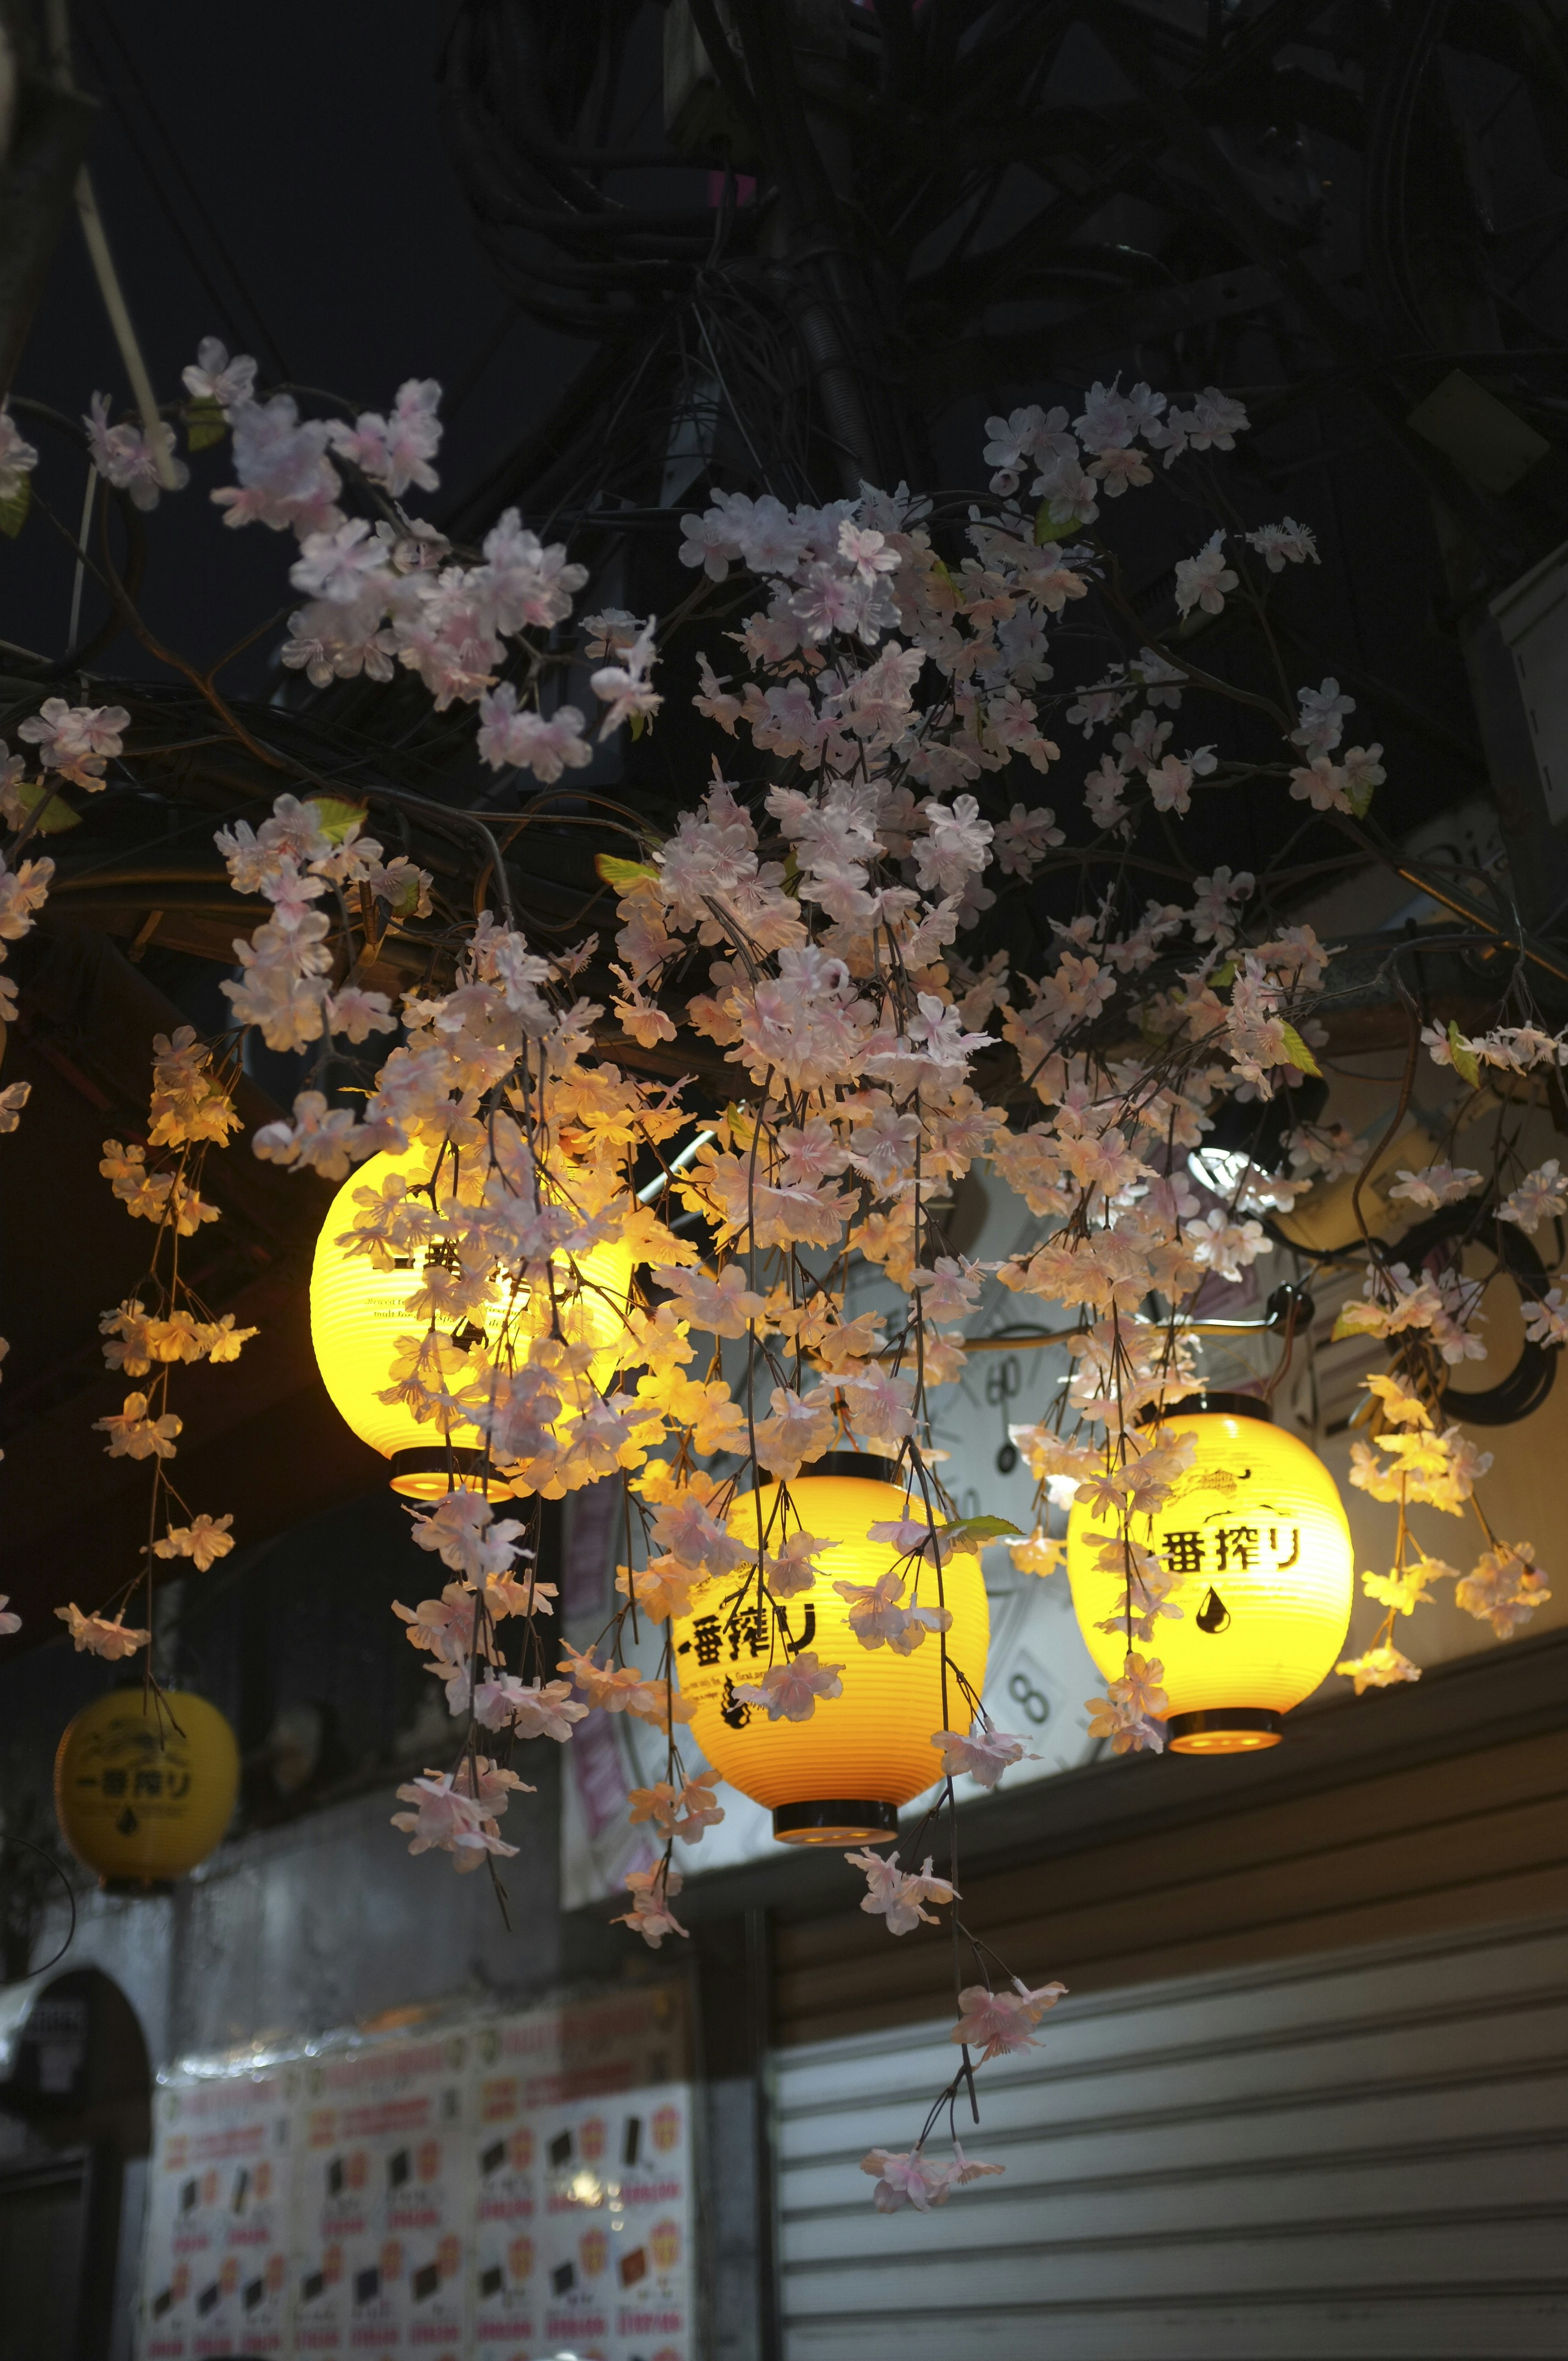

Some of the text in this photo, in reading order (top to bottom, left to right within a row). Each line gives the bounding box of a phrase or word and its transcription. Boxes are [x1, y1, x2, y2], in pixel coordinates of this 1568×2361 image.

[1147, 1526, 1301, 1574] 番搾り
[1008, 1672, 1050, 1726] 8
